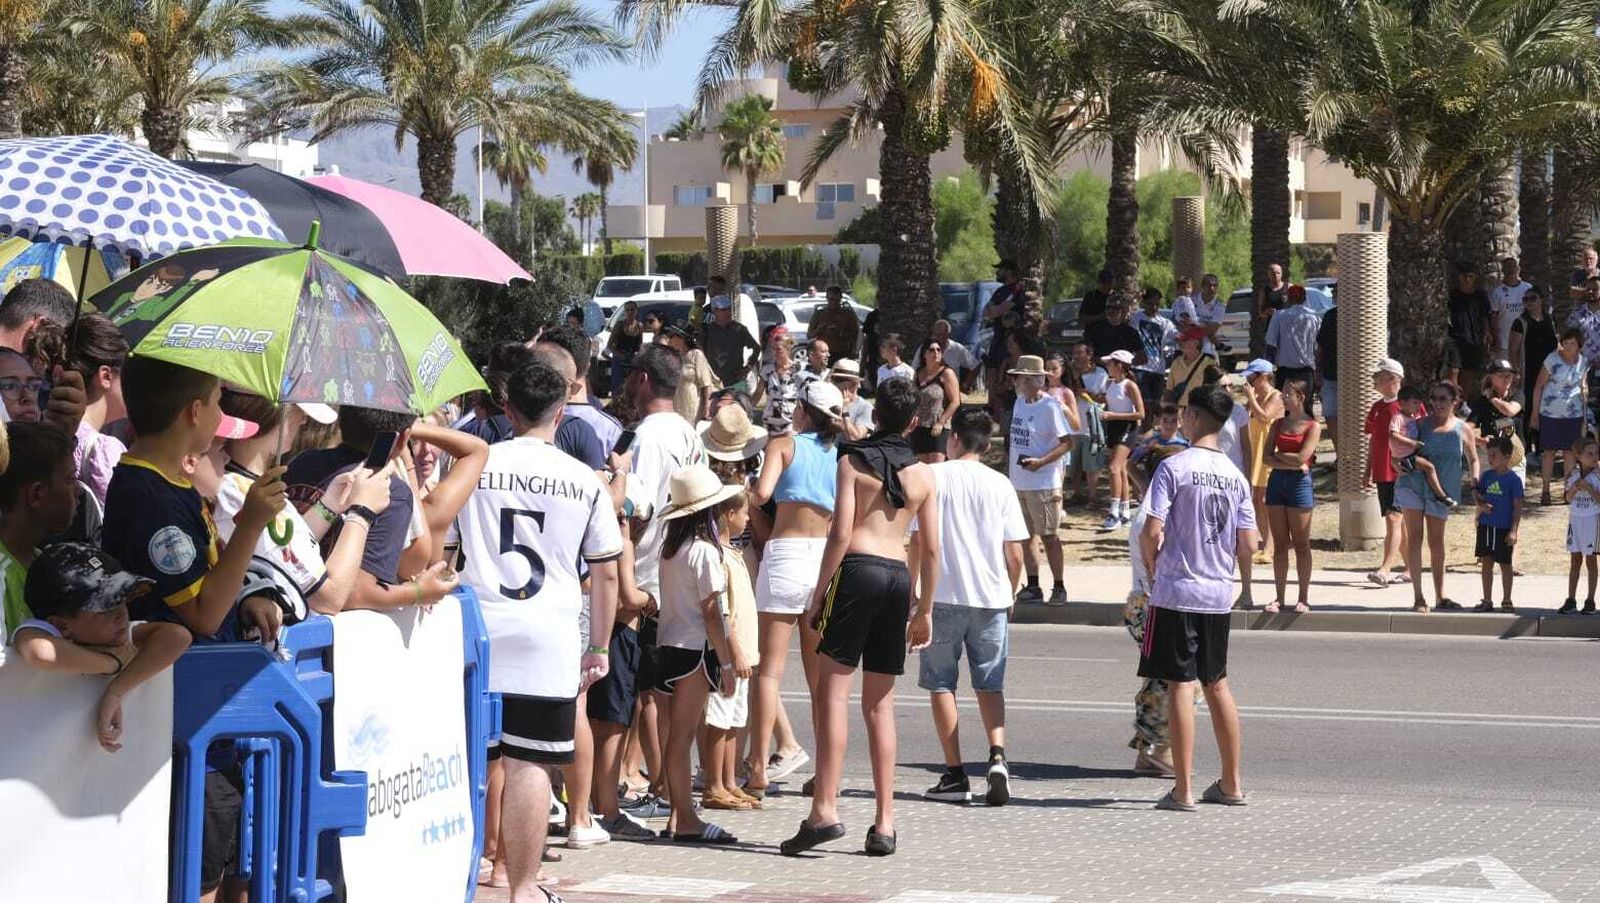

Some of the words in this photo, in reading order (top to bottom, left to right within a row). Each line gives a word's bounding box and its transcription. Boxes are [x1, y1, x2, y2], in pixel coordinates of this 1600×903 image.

[477, 472, 583, 501] ELLINGHAM
[1192, 471, 1239, 492] BENZEMA
[1202, 493, 1231, 544] 9
[500, 508, 546, 600] 5
